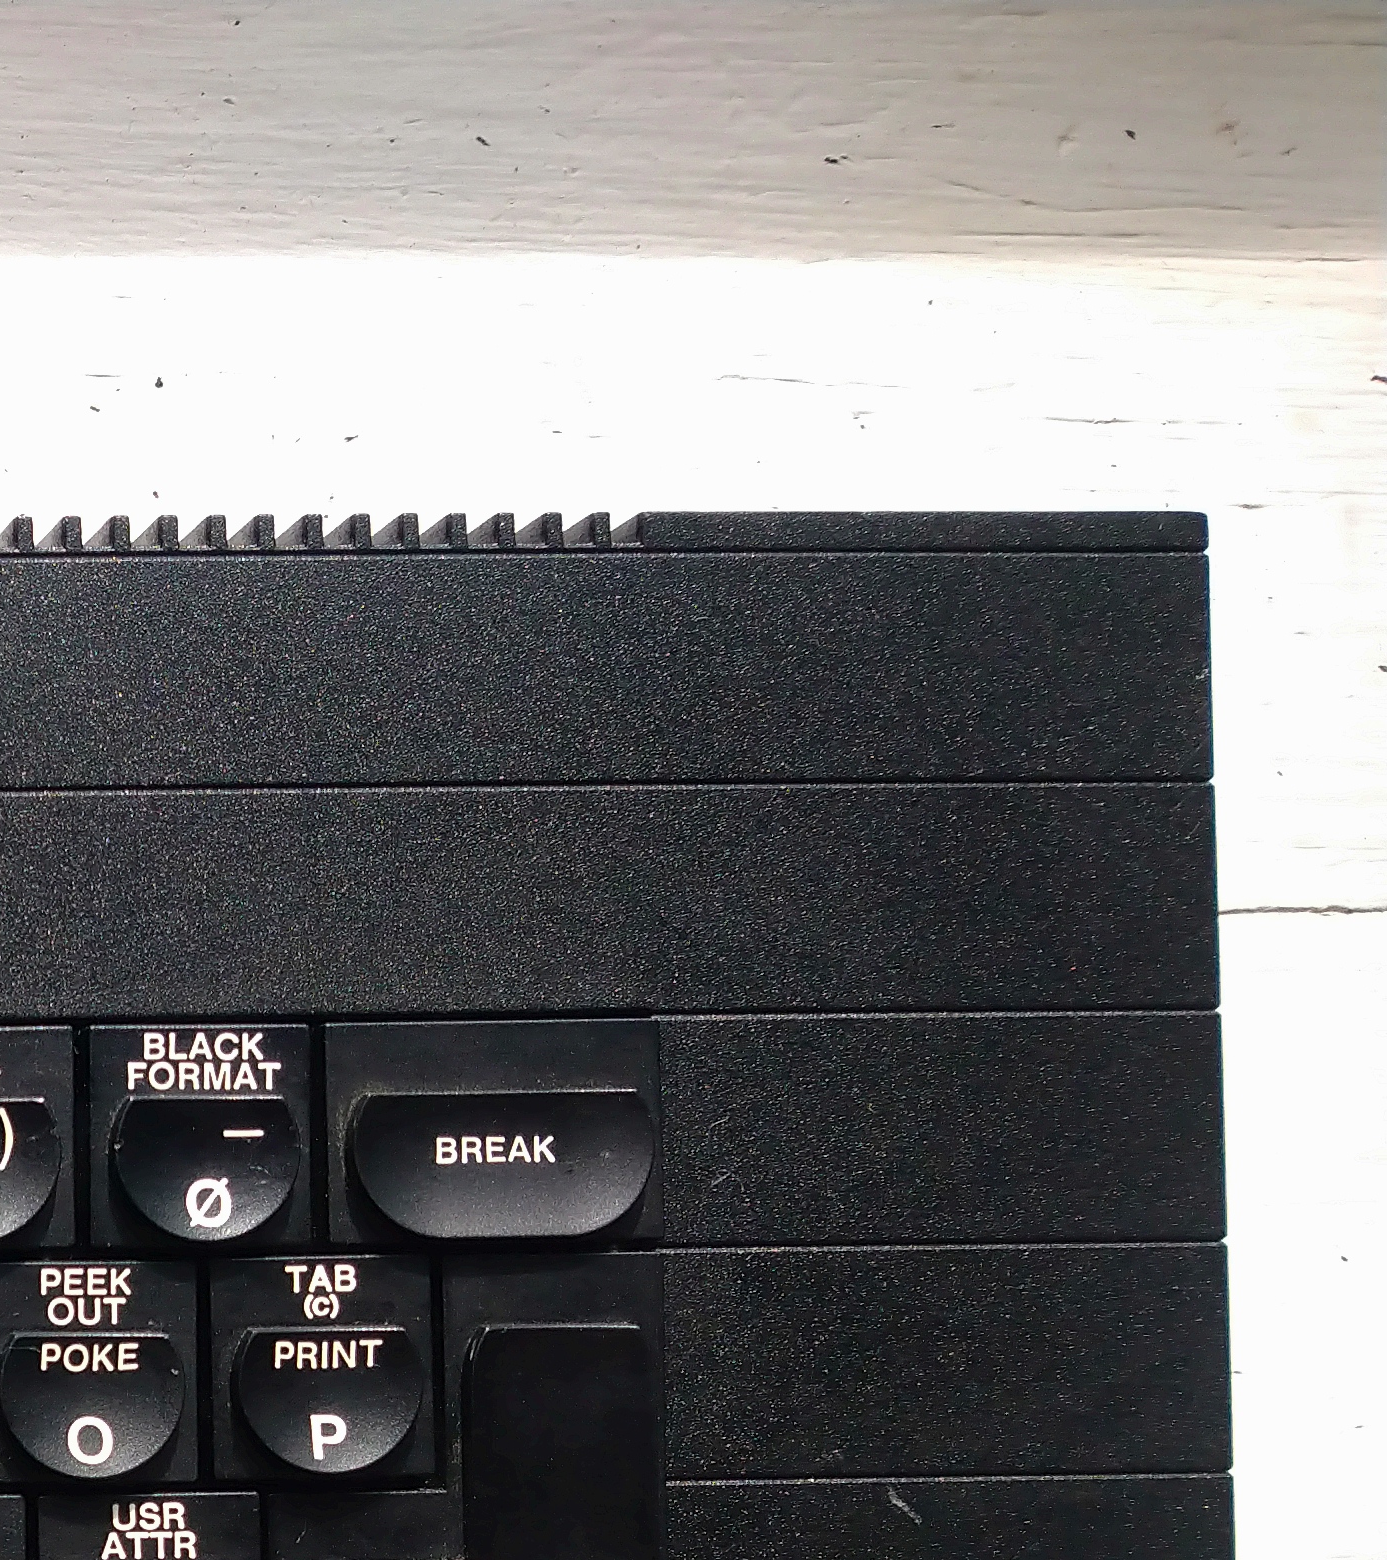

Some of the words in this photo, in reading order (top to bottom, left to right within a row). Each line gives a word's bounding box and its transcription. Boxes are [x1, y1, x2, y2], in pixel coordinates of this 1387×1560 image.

[143, 1031, 264, 1062] BLACK
[127, 1061, 282, 1091] FORMAT
[435, 1135, 556, 1165] BREAK
[40, 1267, 132, 1296] PEEK
[284, 1263, 357, 1294] TAB
[47, 1296, 127, 1326] OUT
[40, 1342, 139, 1373] POKE
[274, 1339, 384, 1370] PRINT
[309, 1414, 347, 1461] P
[112, 1501, 186, 1532] USR
[101, 1530, 197, 1560] ATTR
